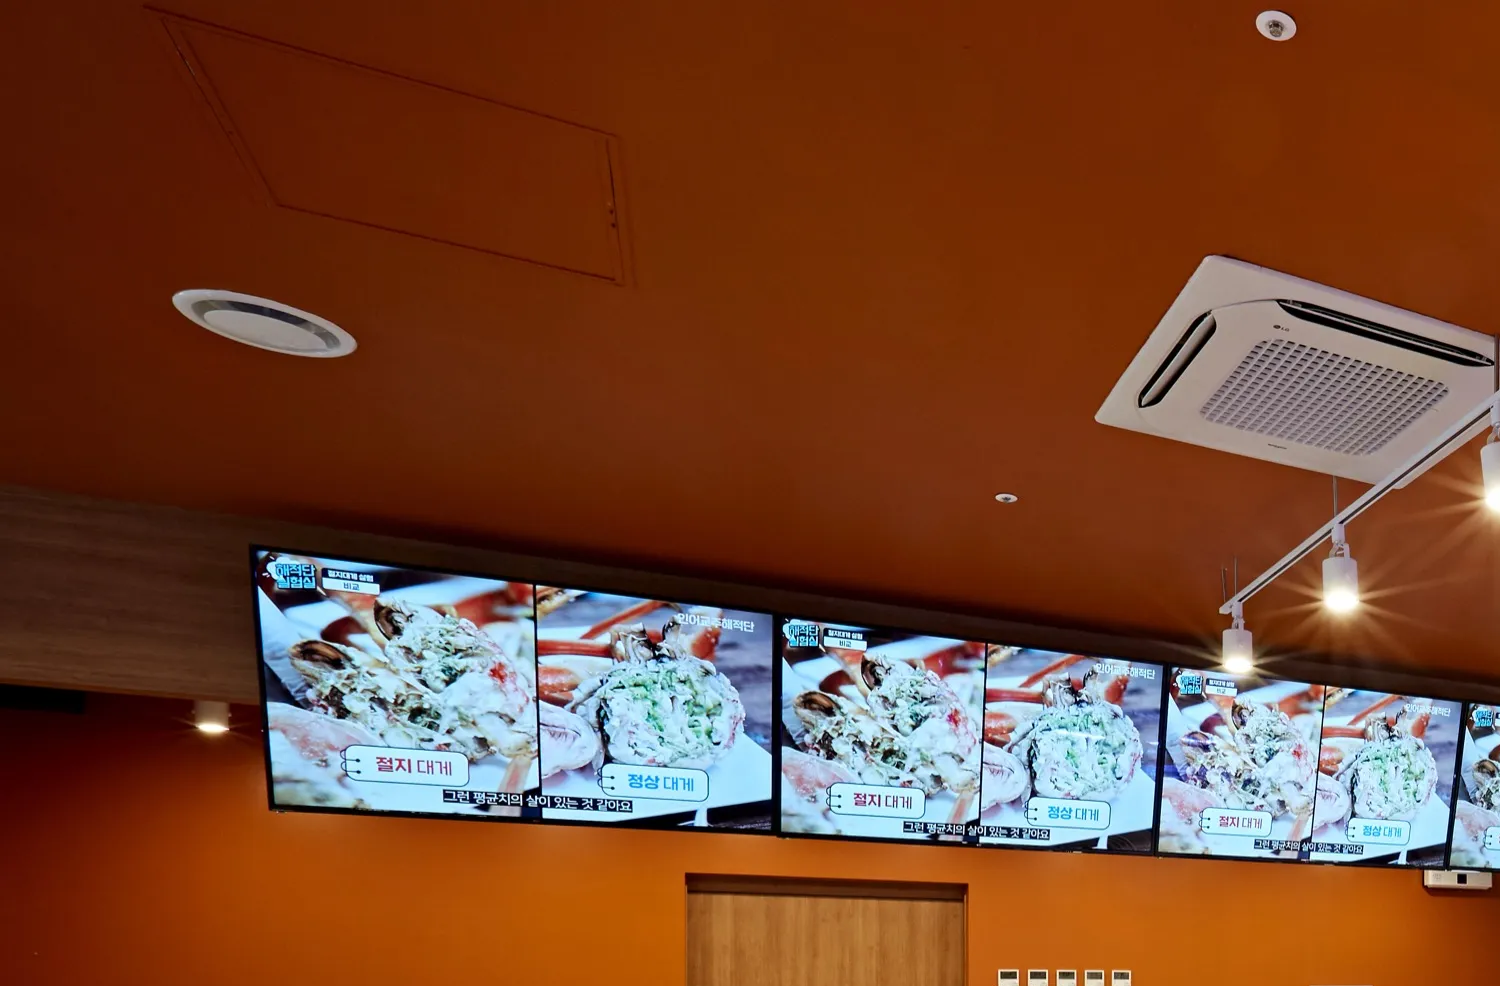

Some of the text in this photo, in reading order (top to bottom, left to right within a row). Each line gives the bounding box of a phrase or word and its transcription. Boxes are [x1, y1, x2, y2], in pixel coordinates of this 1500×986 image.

[275, 563, 316, 577] 해적단
[277, 576, 316, 589] 실험실
[343, 582, 360, 591] 비교
[678, 613, 755, 633] 인어교주해적단
[376, 756, 452, 776] 절지 대게
[628, 774, 694, 791] 정상 대게
[444, 790, 632, 812] 그런 평균치의 살이 있는 것 같아요
[853, 792, 912, 809] 절지 대게
[1048, 806, 1099, 821] 정상 대게
[1219, 815, 1263, 829] 절지 대게
[904, 822, 1049, 839] 그런 평균치의 살이 있는 것 같아요
[1363, 825, 1402, 838] 정상 대게
